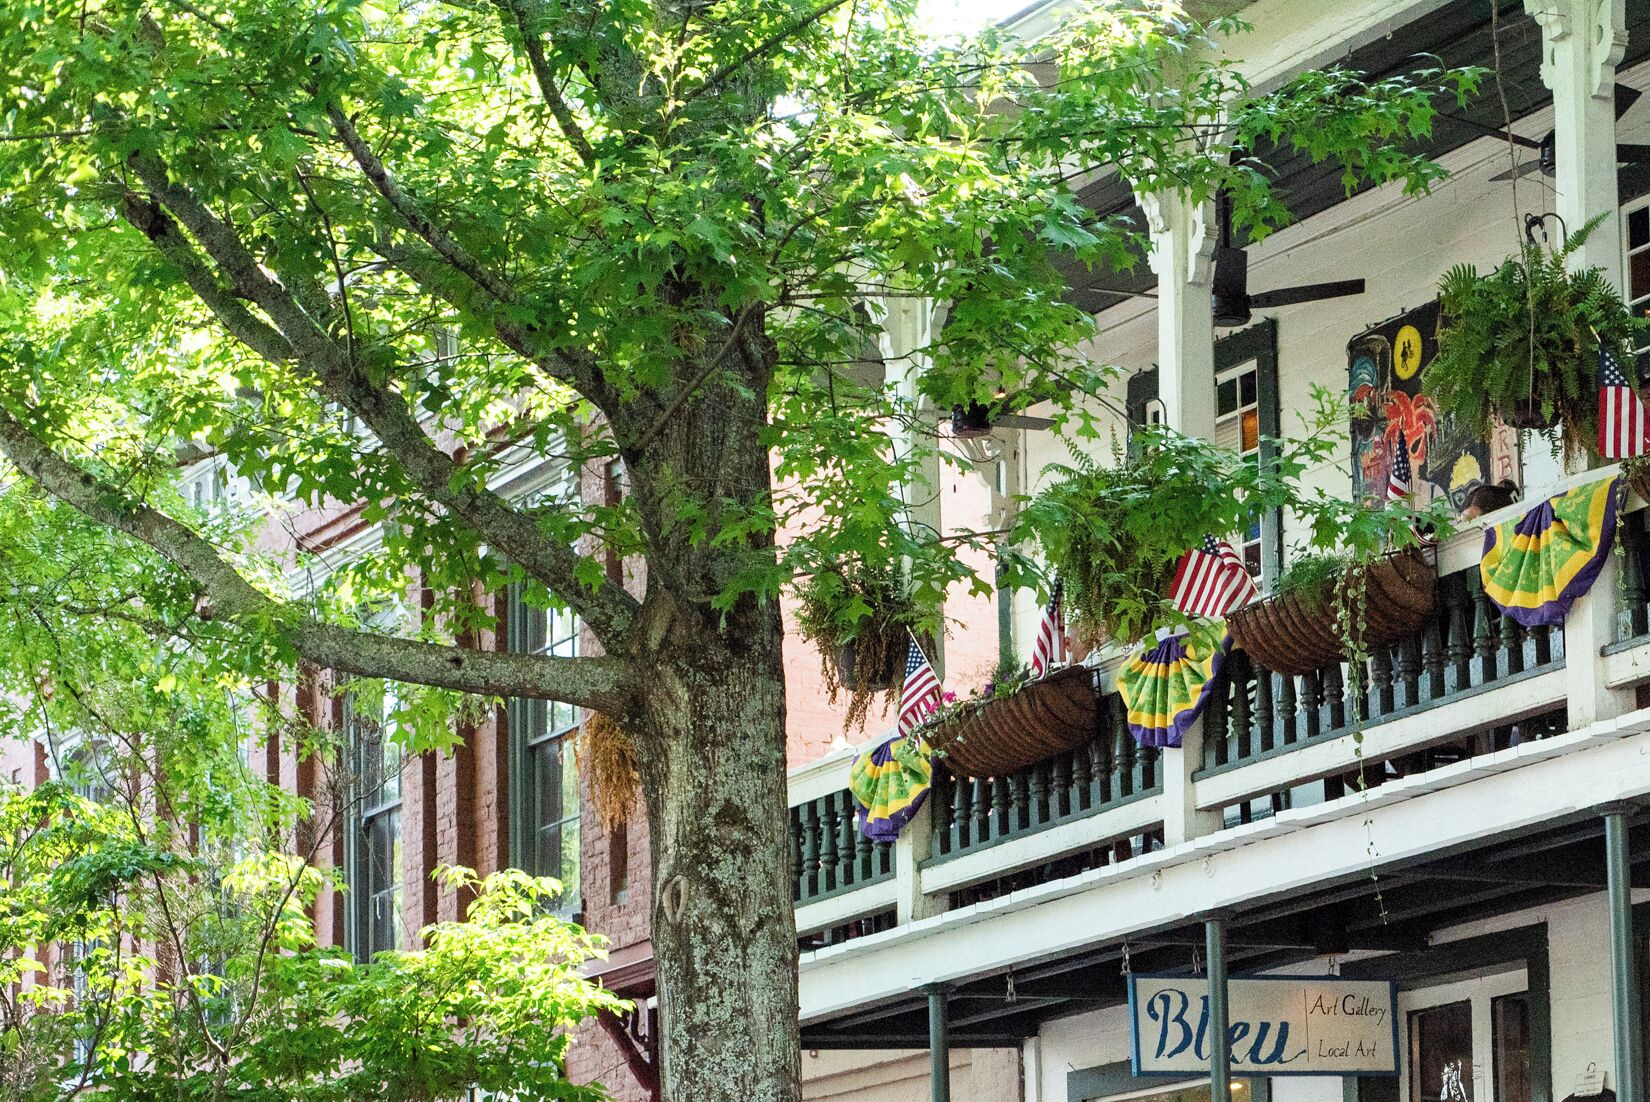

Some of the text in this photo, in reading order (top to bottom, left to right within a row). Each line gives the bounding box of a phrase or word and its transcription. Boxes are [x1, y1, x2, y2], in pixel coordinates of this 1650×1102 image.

[1310, 994, 1386, 1026] Art Gallery
[1146, 988, 1307, 1065] Bleu
[1318, 1039, 1376, 1058] Local Art
